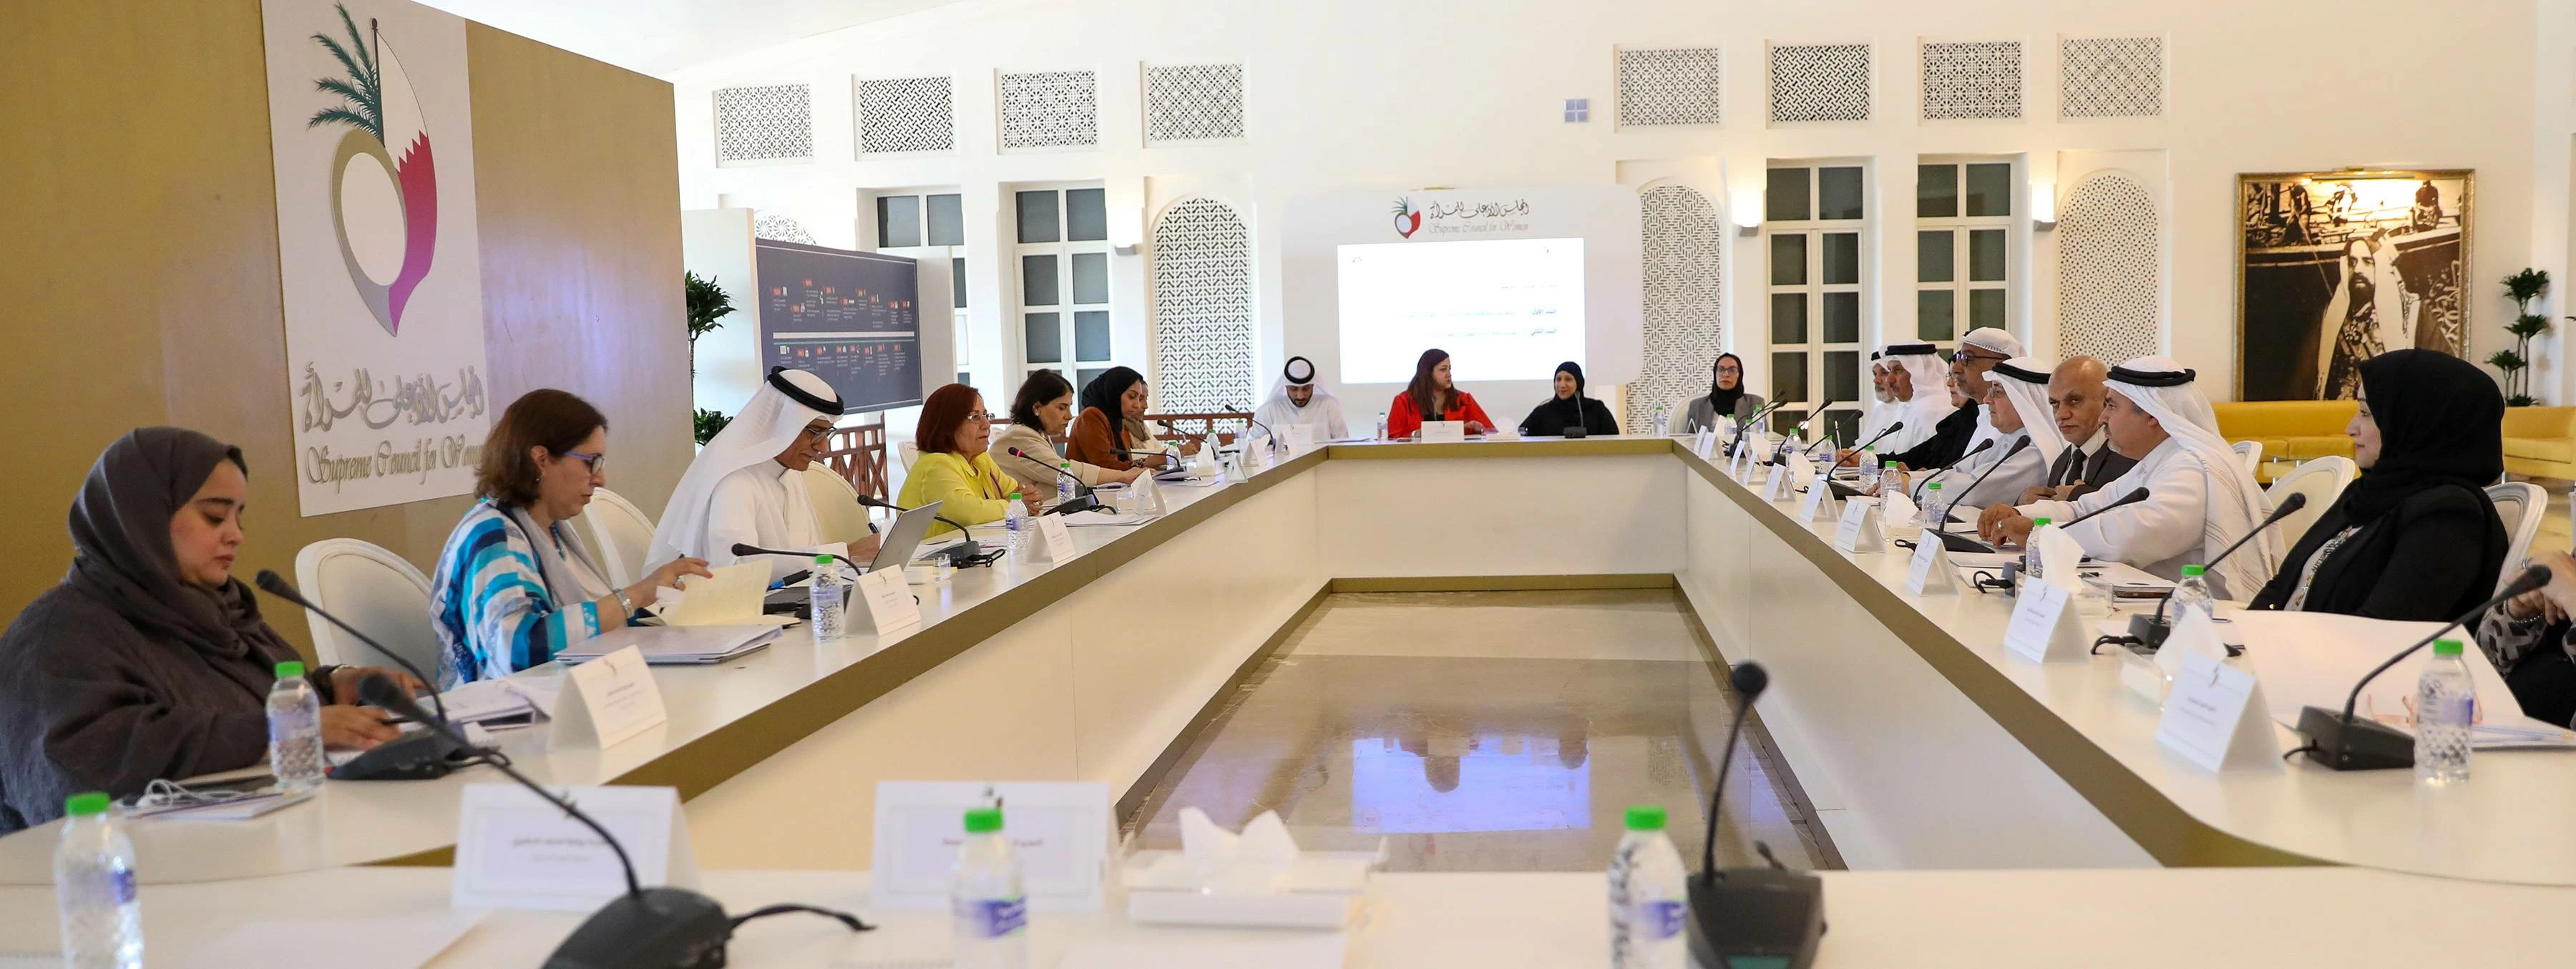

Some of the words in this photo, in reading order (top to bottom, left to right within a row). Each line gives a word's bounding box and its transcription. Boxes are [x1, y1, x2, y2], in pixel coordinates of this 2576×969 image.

[1429, 222, 1460, 236] Supreme
[1462, 220, 1488, 234] Council
[1488, 221, 1497, 235] for
[1500, 220, 1528, 232] Women
[306, 444, 372, 494] Supreme
[376, 438, 422, 478] Council
[419, 437, 437, 485] for
[441, 434, 482, 469] Wom
